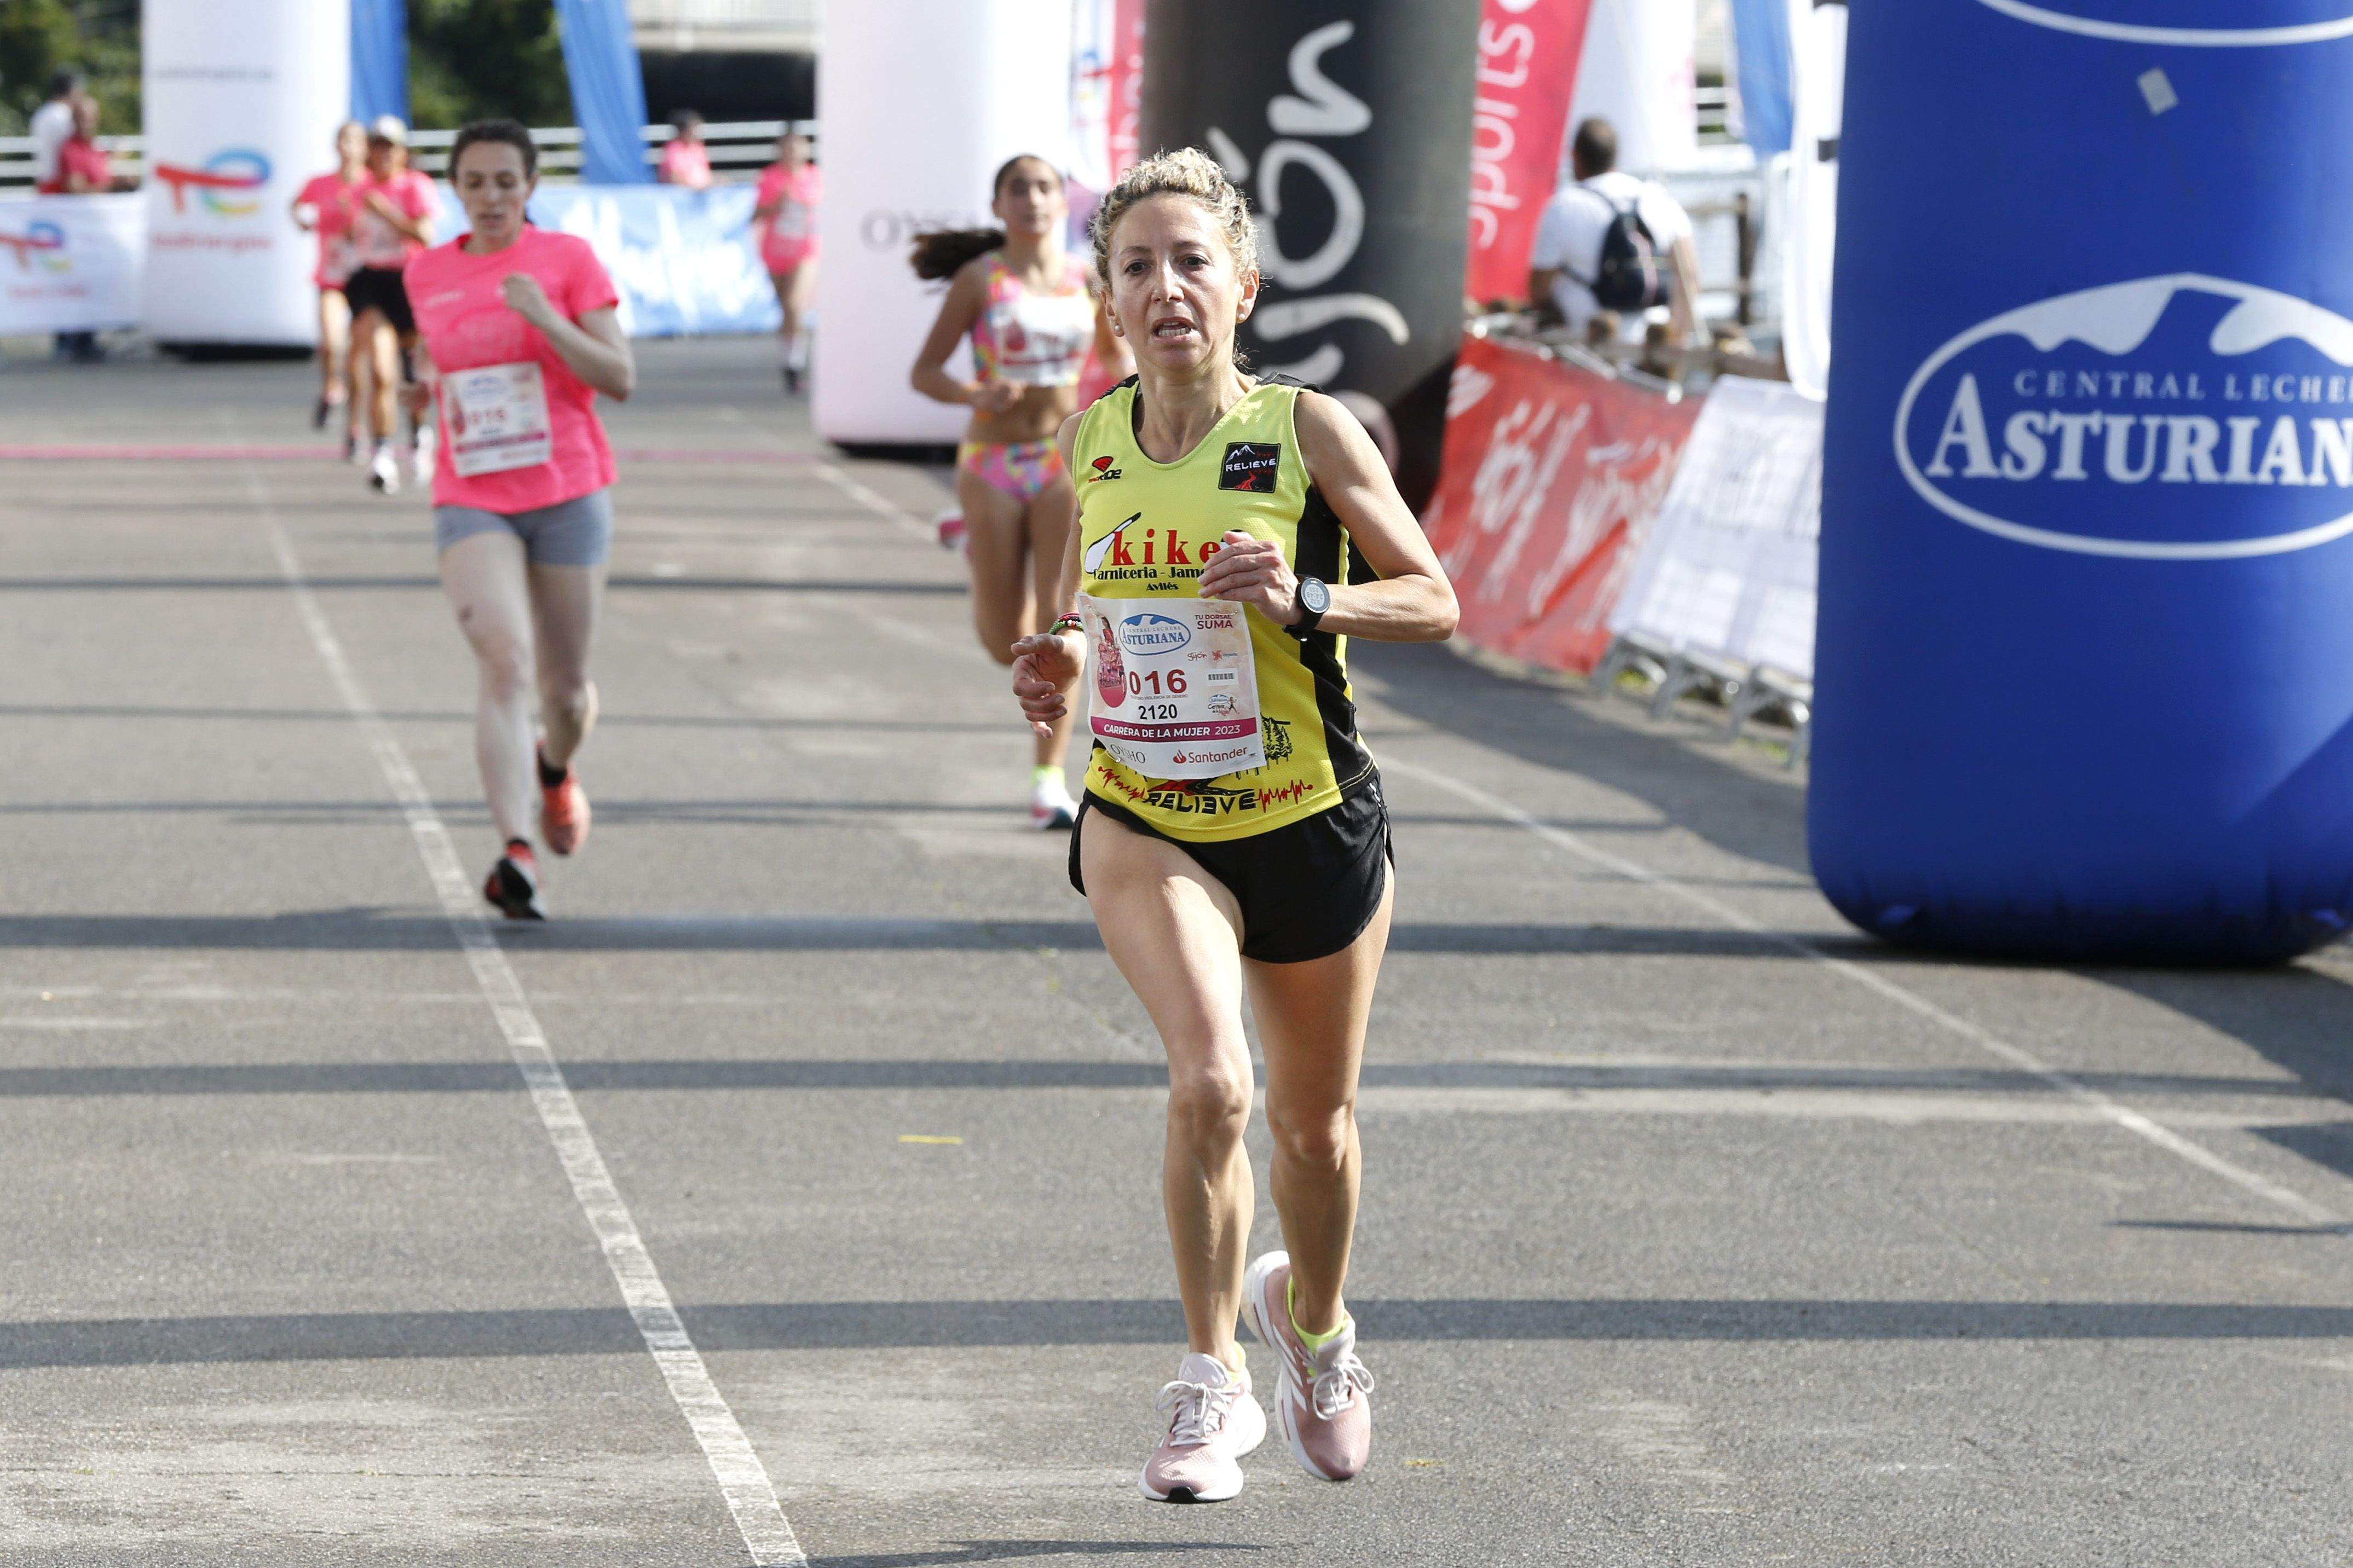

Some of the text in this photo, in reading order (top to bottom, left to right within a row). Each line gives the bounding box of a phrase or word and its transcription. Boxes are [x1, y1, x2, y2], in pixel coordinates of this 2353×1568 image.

[2014, 368, 2206, 401] CENTRAL
[1225, 458, 1277, 472] RELIEVE
[1111, 528, 1221, 566] kike
[1197, 620, 1233, 629] SUMA
[1122, 628, 1185, 645] ASTURIANA
[1187, 651, 1207, 662] gijón
[1129, 669, 1187, 695] 016
[1138, 704, 1178, 720] 2120
[1104, 724, 1241, 738] CARRERA DE LA MUJER 2023
[1189, 747, 1248, 763] Santander
